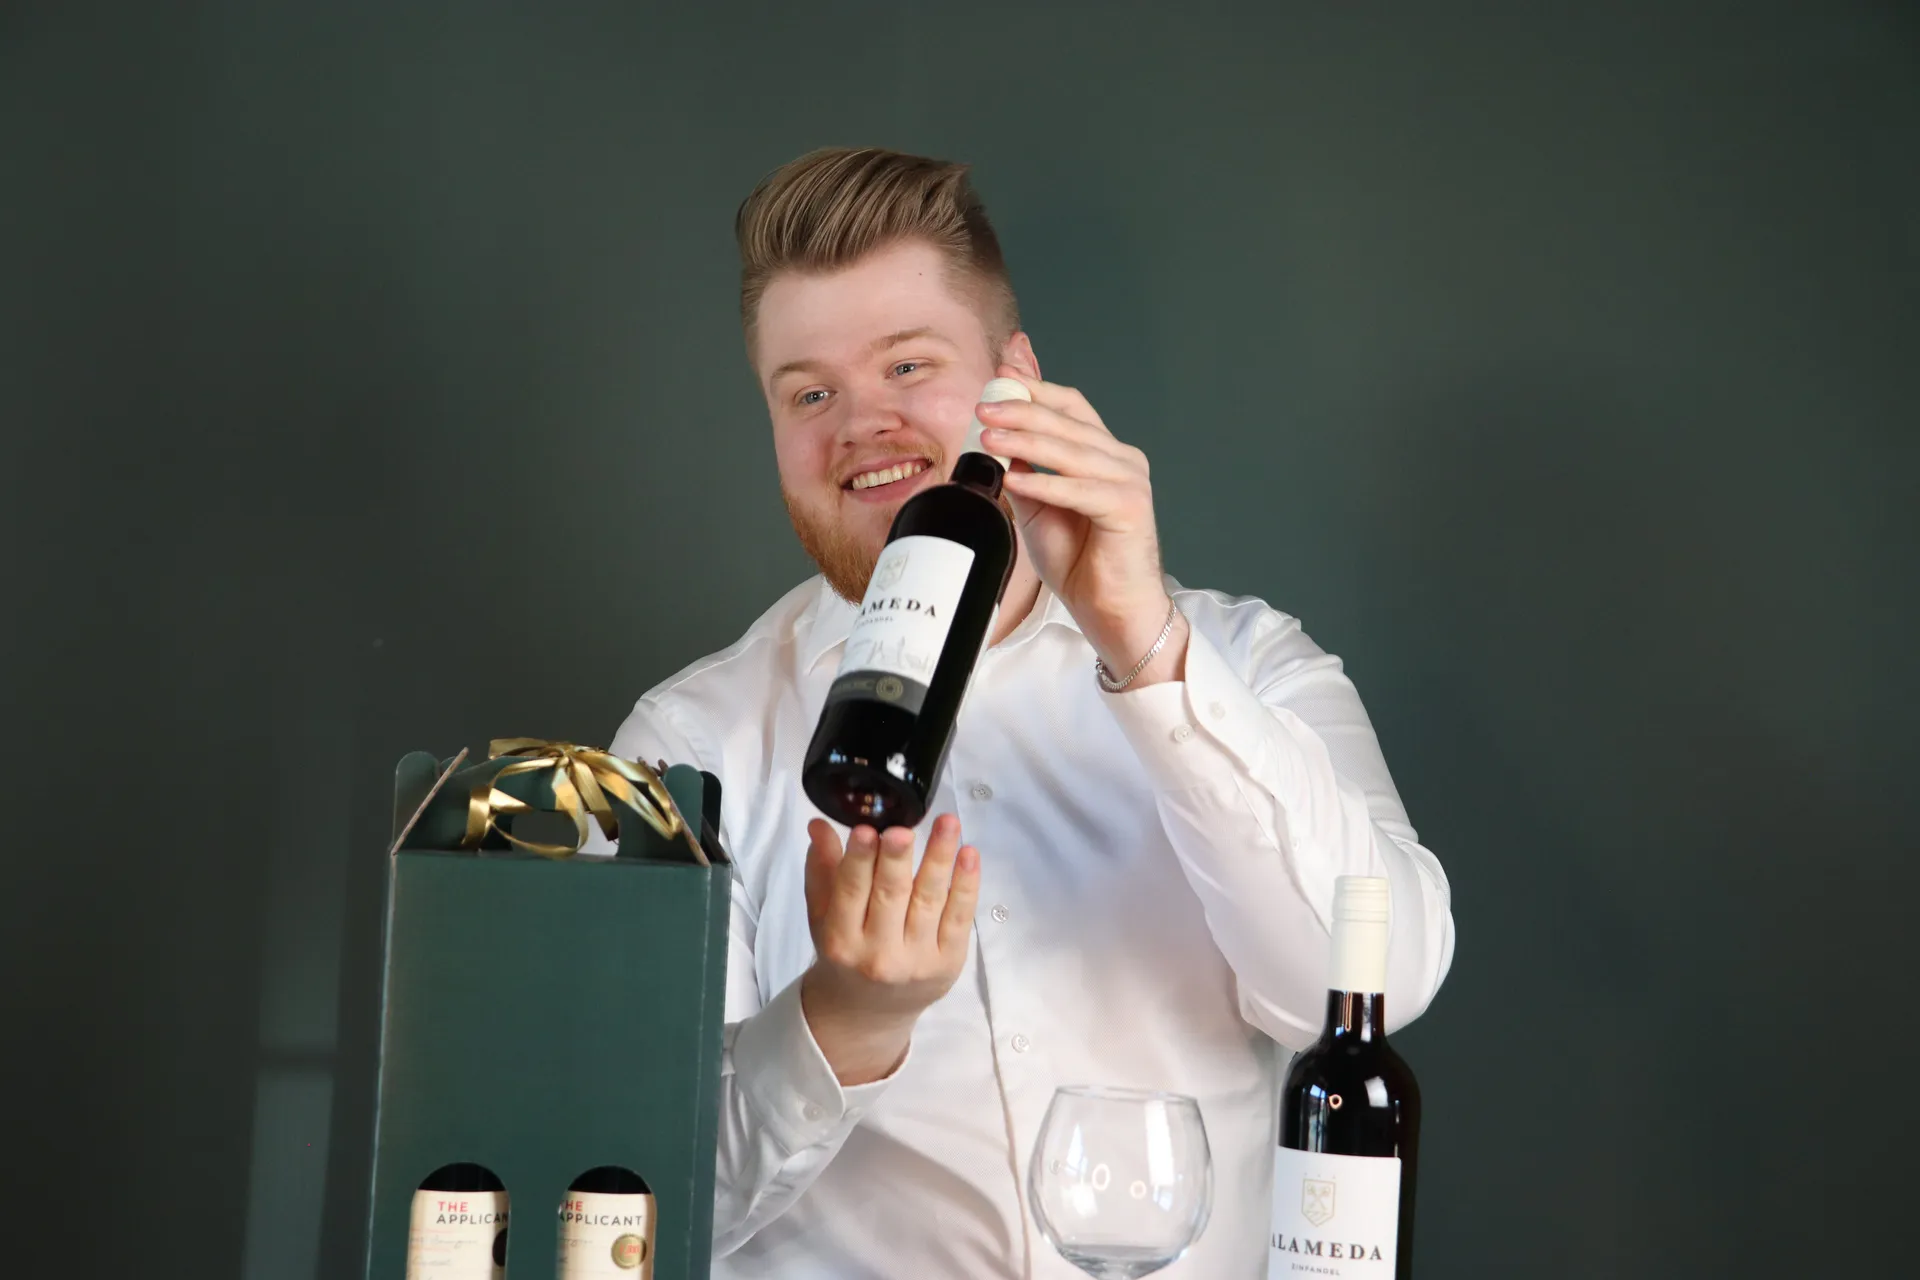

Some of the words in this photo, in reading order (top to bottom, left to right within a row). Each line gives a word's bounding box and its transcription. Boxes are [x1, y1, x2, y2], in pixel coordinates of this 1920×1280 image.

[438, 1201, 468, 1212] THE
[561, 1200, 583, 1212] HE
[1271, 1232, 1382, 1261] ALAMEDA
[1291, 1262, 1341, 1276] ZINFANDEL
